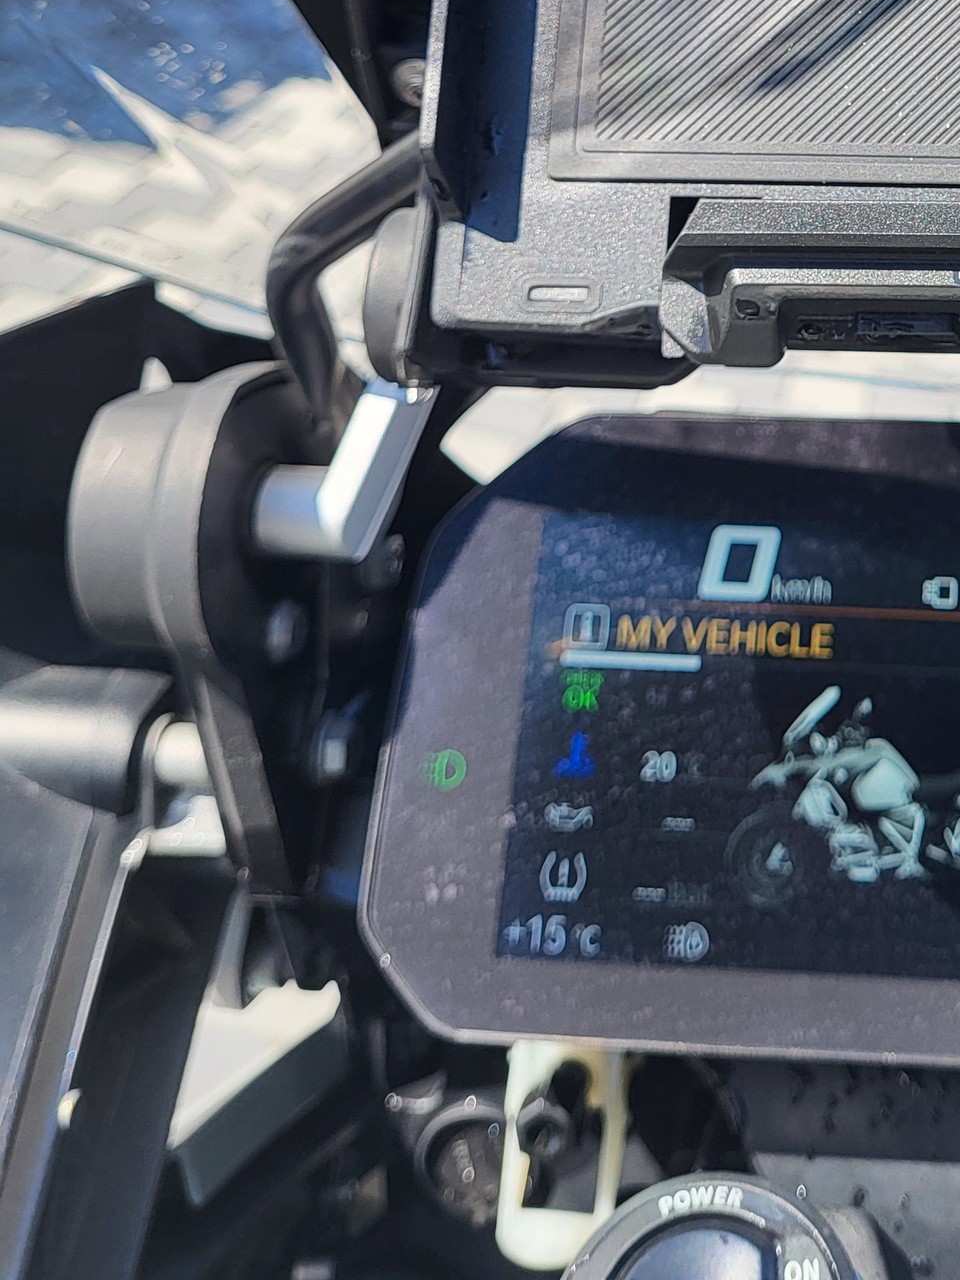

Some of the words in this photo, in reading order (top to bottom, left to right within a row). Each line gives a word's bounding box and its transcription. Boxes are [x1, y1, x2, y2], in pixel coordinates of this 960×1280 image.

[697, 524, 782, 603] 0
[615, 613, 677, 651] MY
[681, 616, 835, 660] VEHICLE
[639, 749, 678, 783] 20
[657, 1185, 745, 1219] POWER
[783, 1256, 820, 1280] ON
